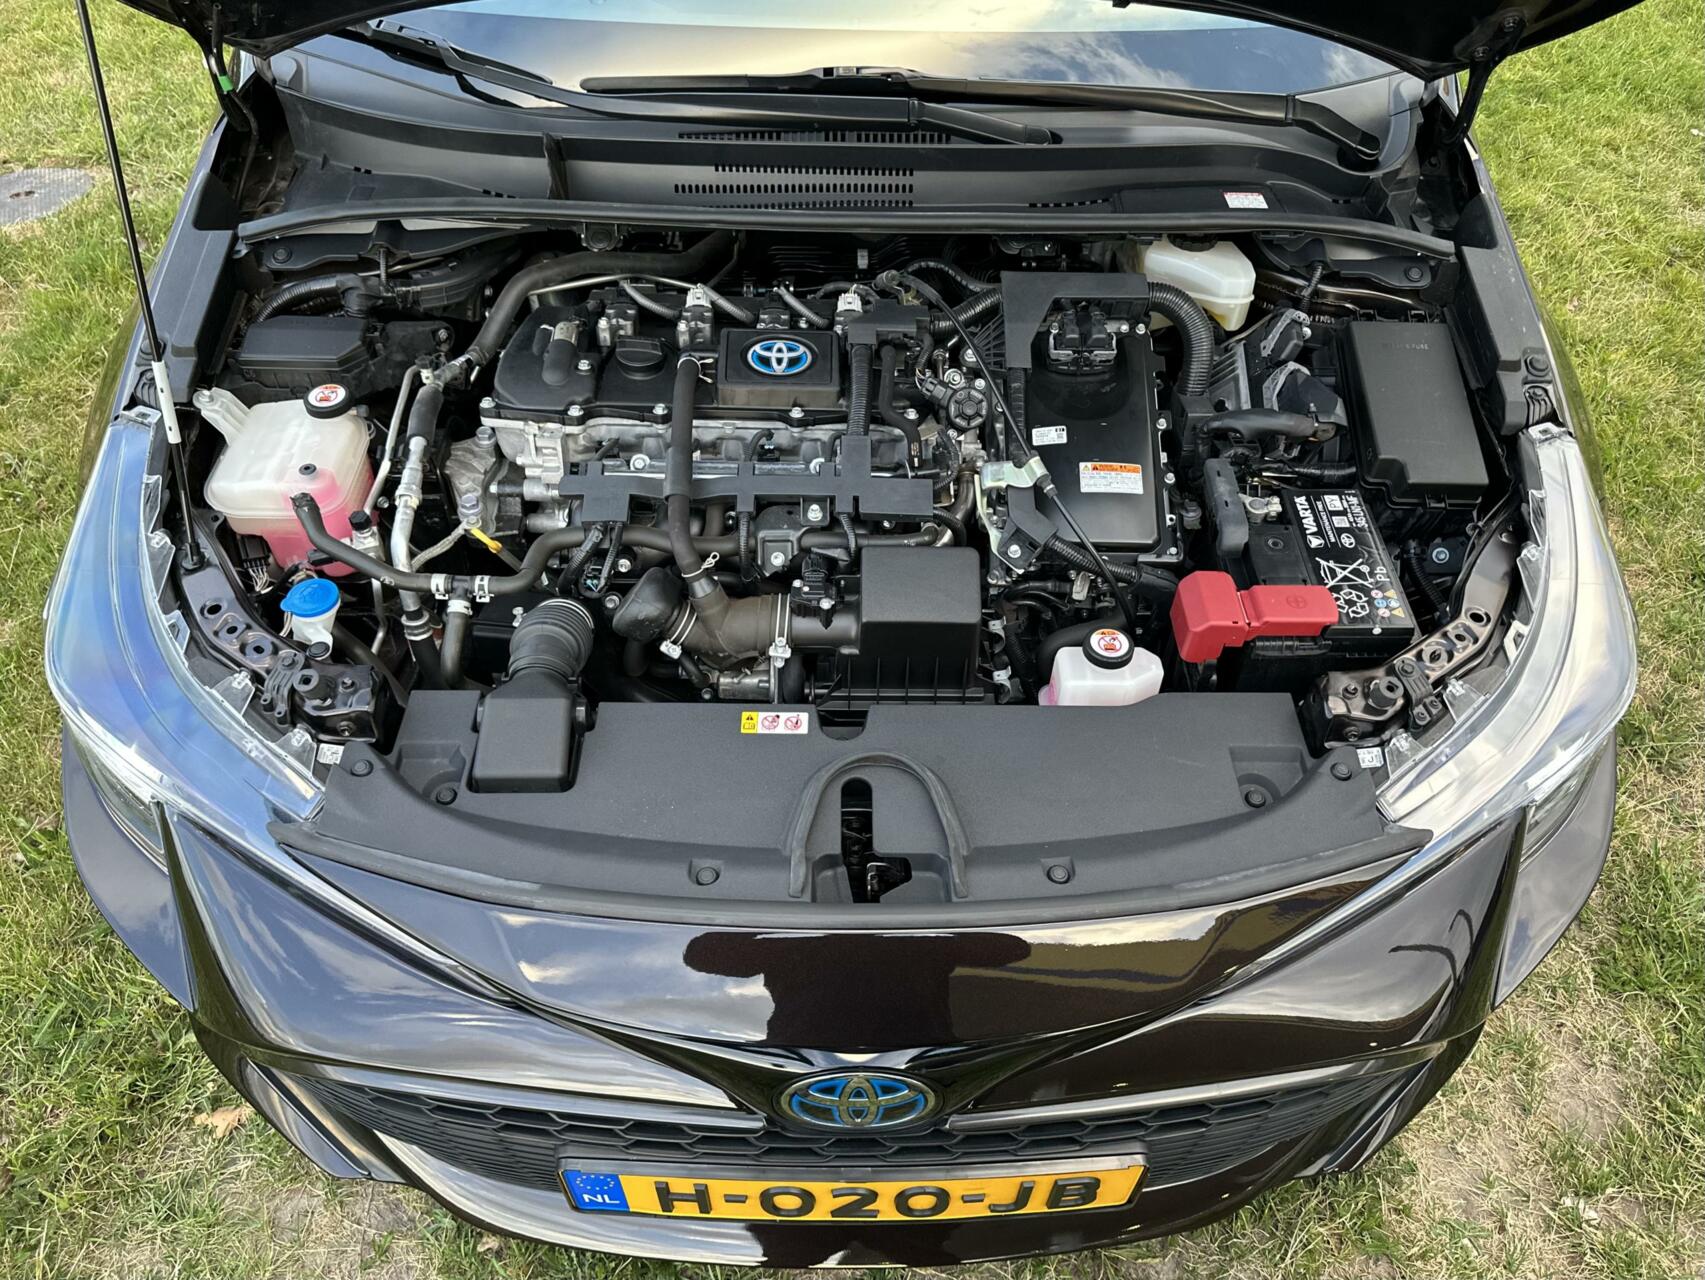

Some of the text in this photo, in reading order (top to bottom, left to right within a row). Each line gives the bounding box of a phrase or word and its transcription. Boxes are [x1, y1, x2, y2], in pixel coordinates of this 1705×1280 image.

[1294, 495, 1318, 535] VARTA
[1374, 566, 1390, 581] Pb
[582, 1193, 620, 1204] NL
[654, 1176, 1101, 1219] H-020-JB
